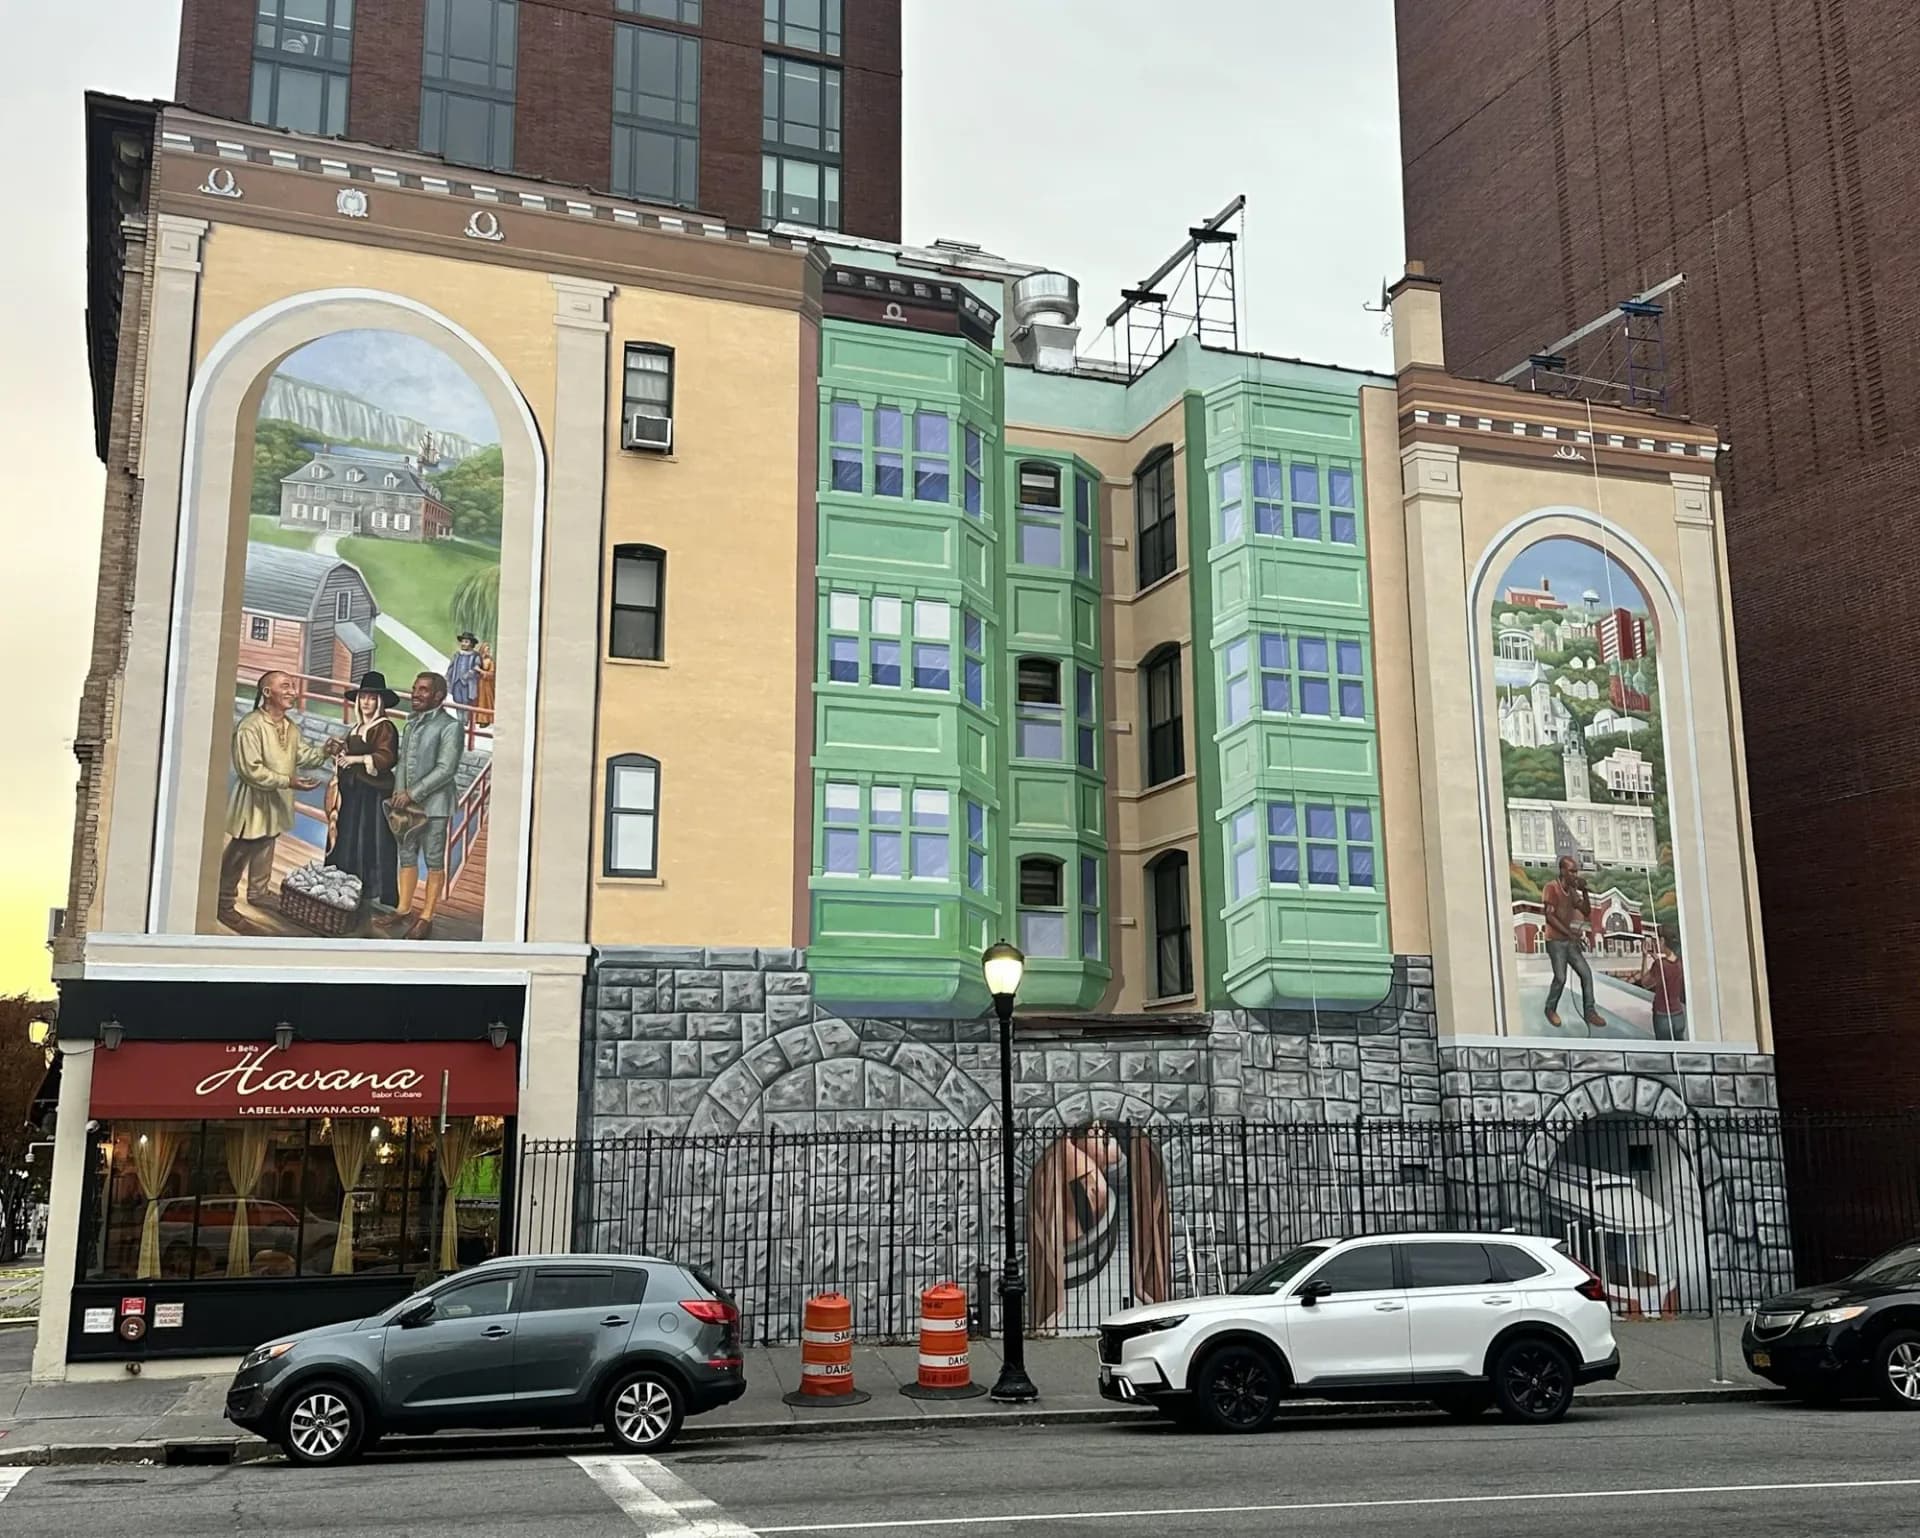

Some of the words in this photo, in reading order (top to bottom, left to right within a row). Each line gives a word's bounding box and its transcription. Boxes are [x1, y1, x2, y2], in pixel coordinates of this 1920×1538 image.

[225, 1045, 237, 1053] La
[238, 1044, 259, 1053] Bella
[195, 1044, 425, 1096] Havana
[371, 1090, 393, 1099] Sabor
[393, 1090, 423, 1099] Cubano
[238, 1105, 381, 1115] LABELLAHAVANA.COM
